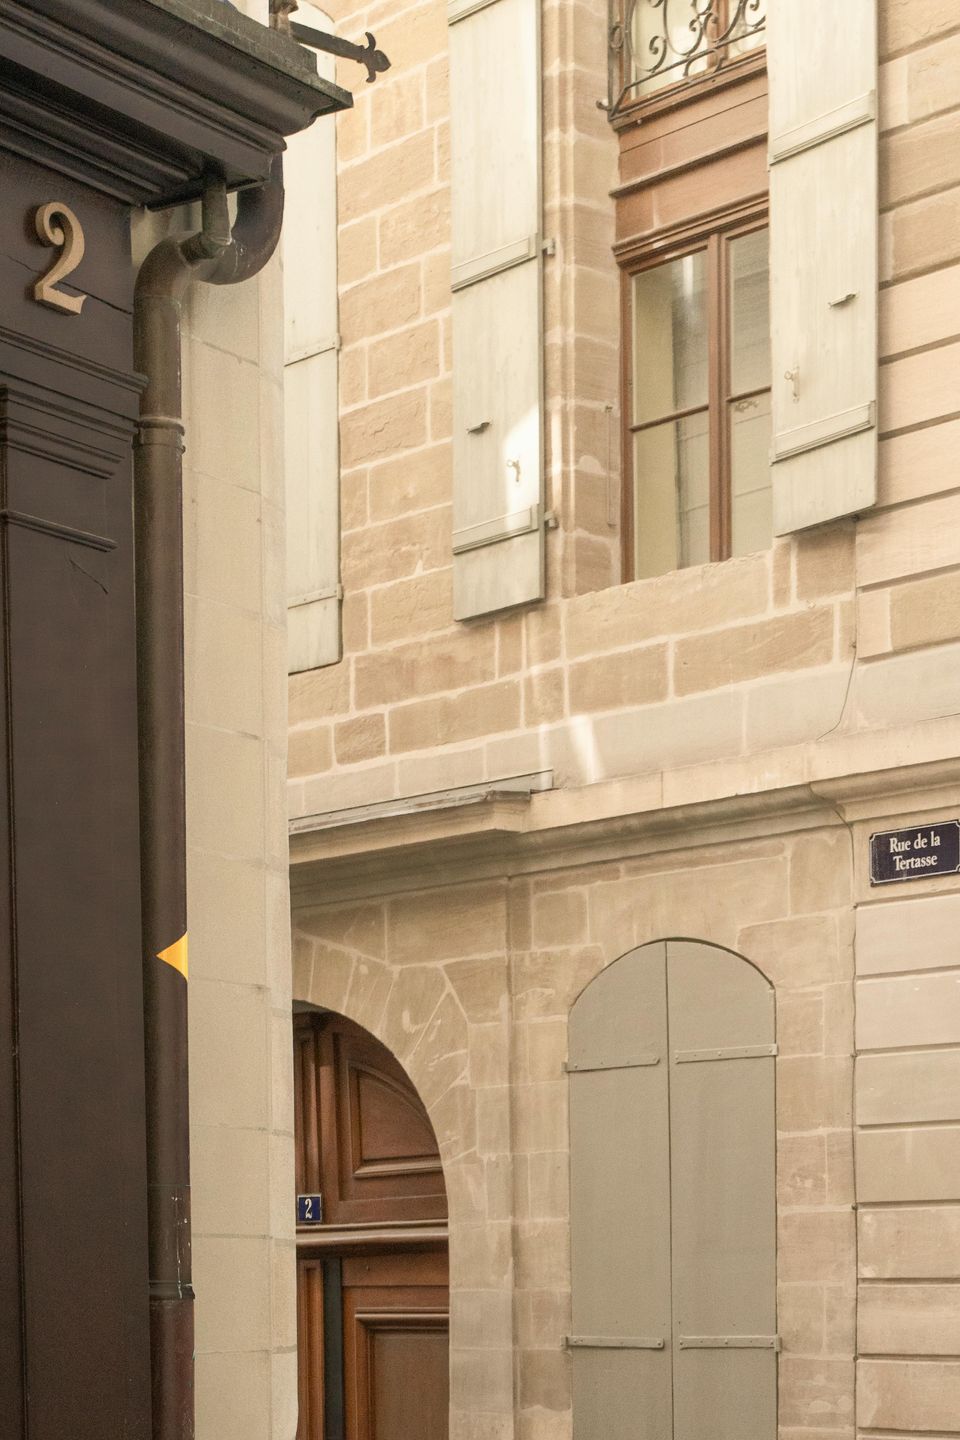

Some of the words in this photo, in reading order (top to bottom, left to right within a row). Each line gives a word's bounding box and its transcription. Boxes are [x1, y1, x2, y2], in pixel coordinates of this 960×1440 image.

[34, 201, 88, 317] 2
[889, 837, 911, 853] Rue
[913, 832, 928, 849] de
[930, 831, 941, 847] la
[893, 855, 938, 871] Tertasse
[304, 1198, 313, 1219] 2
